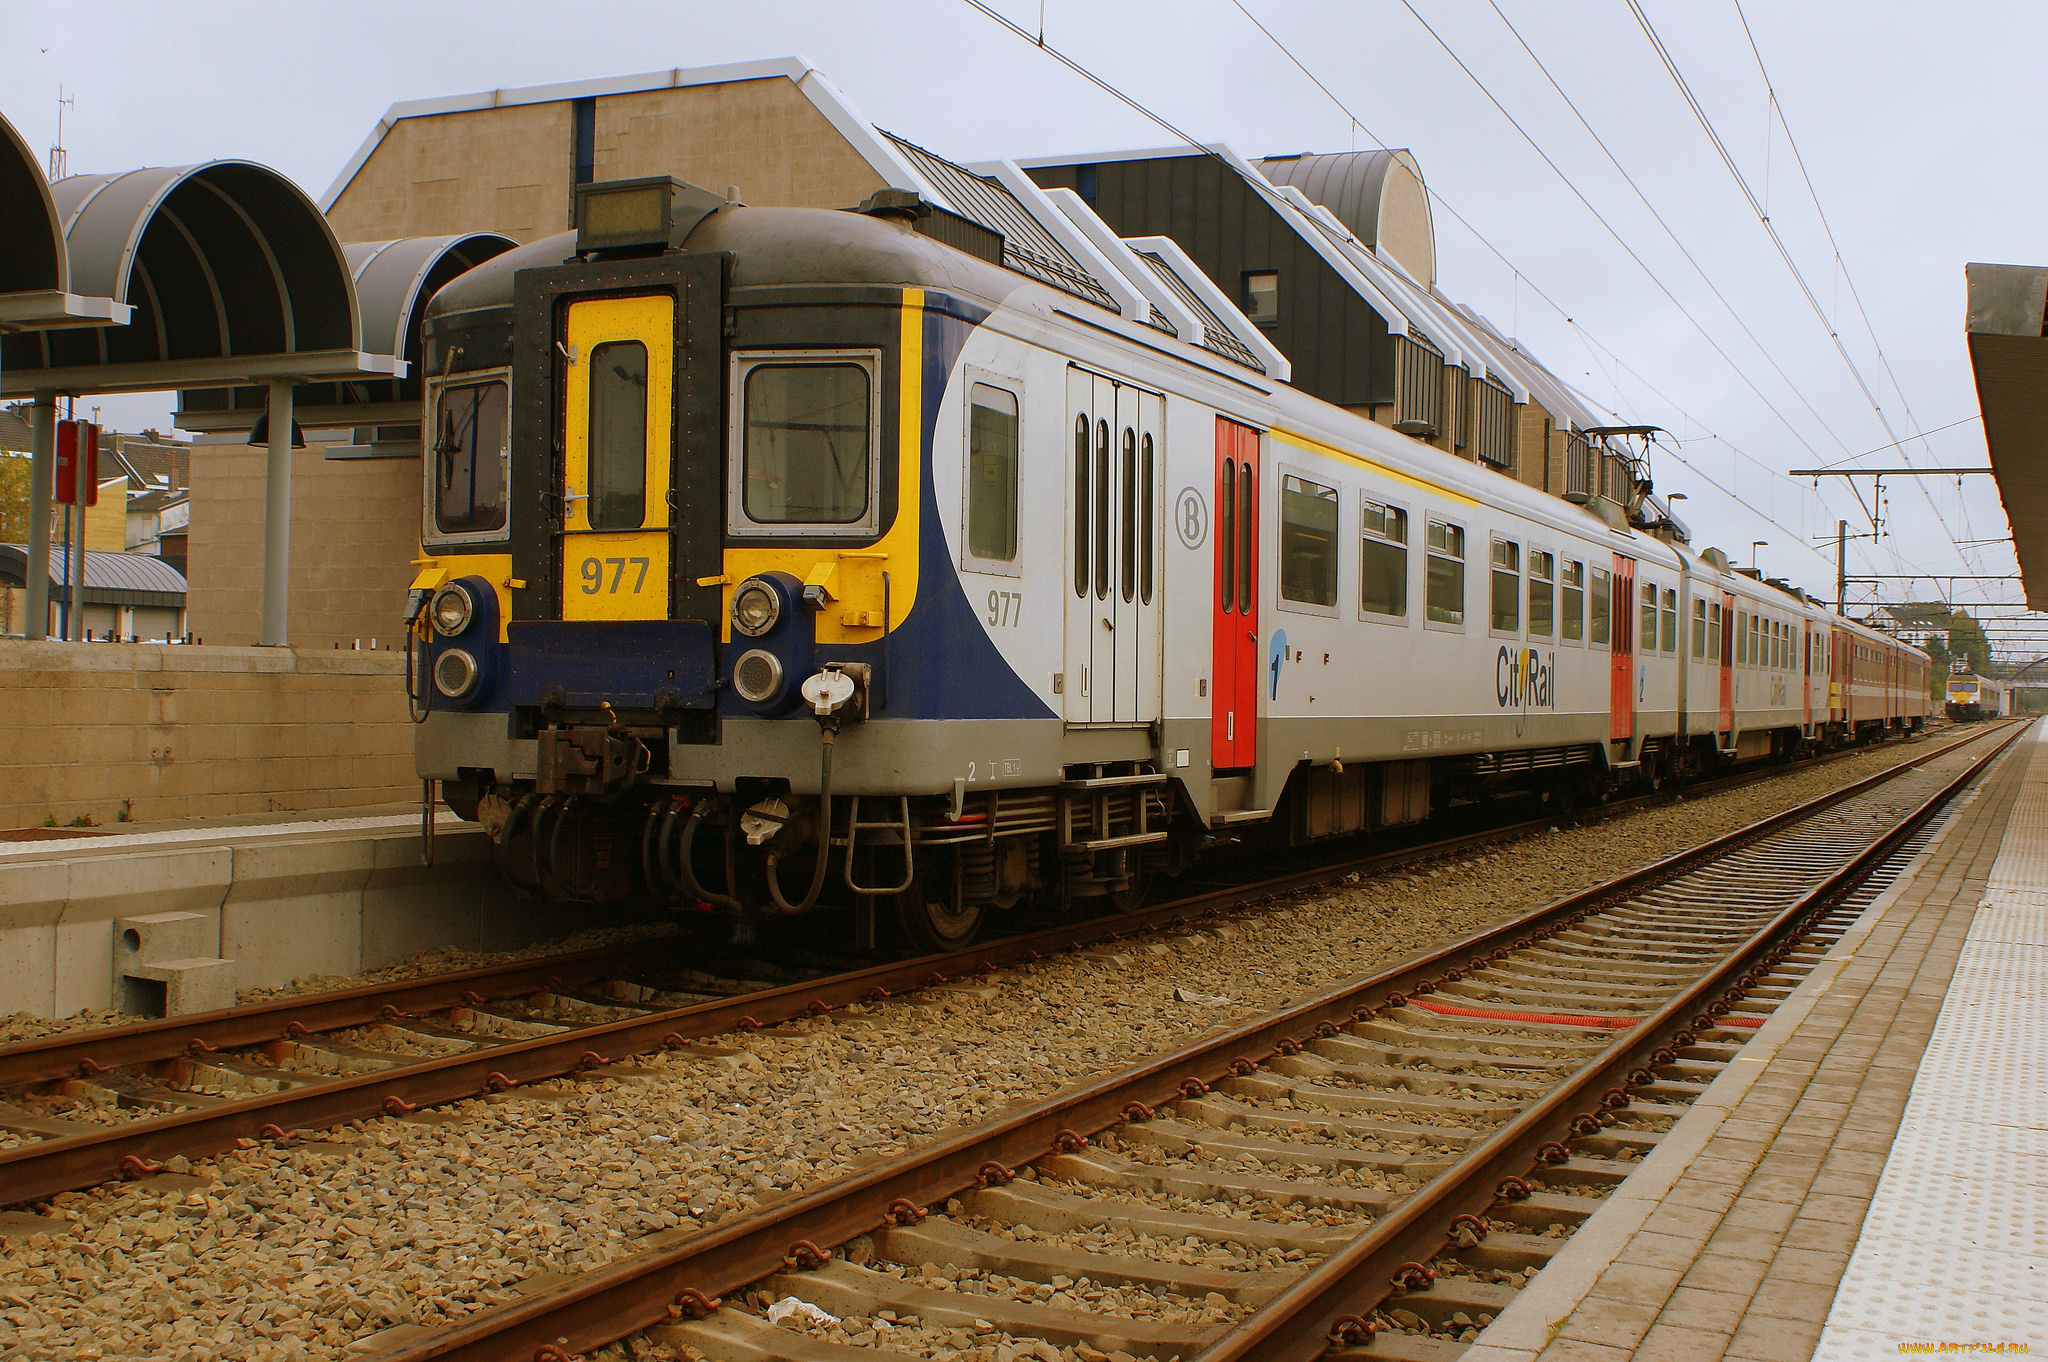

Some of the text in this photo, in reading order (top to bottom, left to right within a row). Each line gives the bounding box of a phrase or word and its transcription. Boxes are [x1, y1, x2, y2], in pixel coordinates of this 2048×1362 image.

[581, 557, 649, 595] 977
[988, 589, 1022, 628] 977
[1271, 653, 1279, 701] 1
[1496, 645, 1555, 738] CityRail
[968, 761, 976, 782] 2
